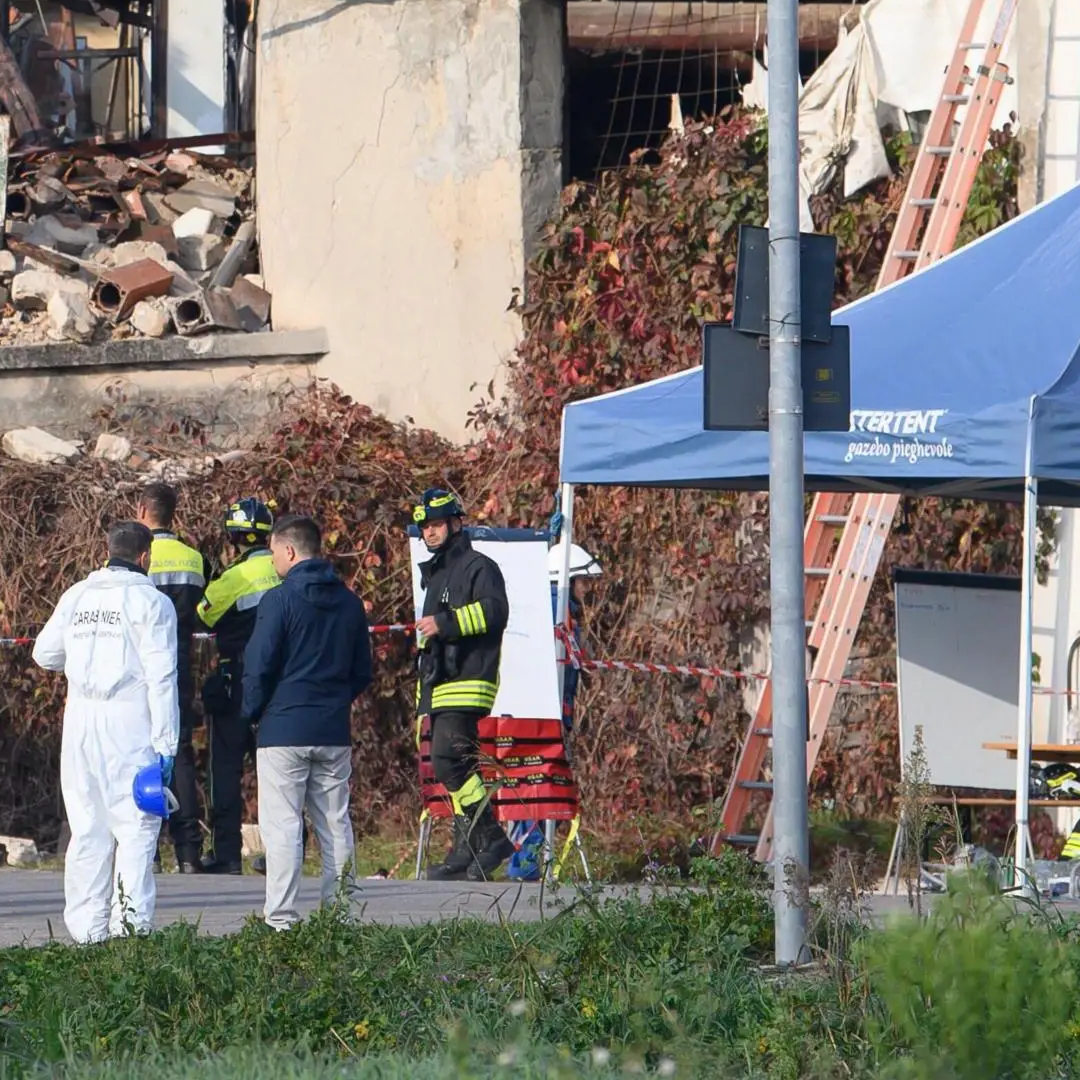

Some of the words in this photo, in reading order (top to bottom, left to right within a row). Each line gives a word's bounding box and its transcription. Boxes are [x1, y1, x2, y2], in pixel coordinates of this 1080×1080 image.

[849, 409, 944, 434] STERTENT
[844, 436, 890, 463] gazebo
[890, 437, 954, 463] pieghevole
